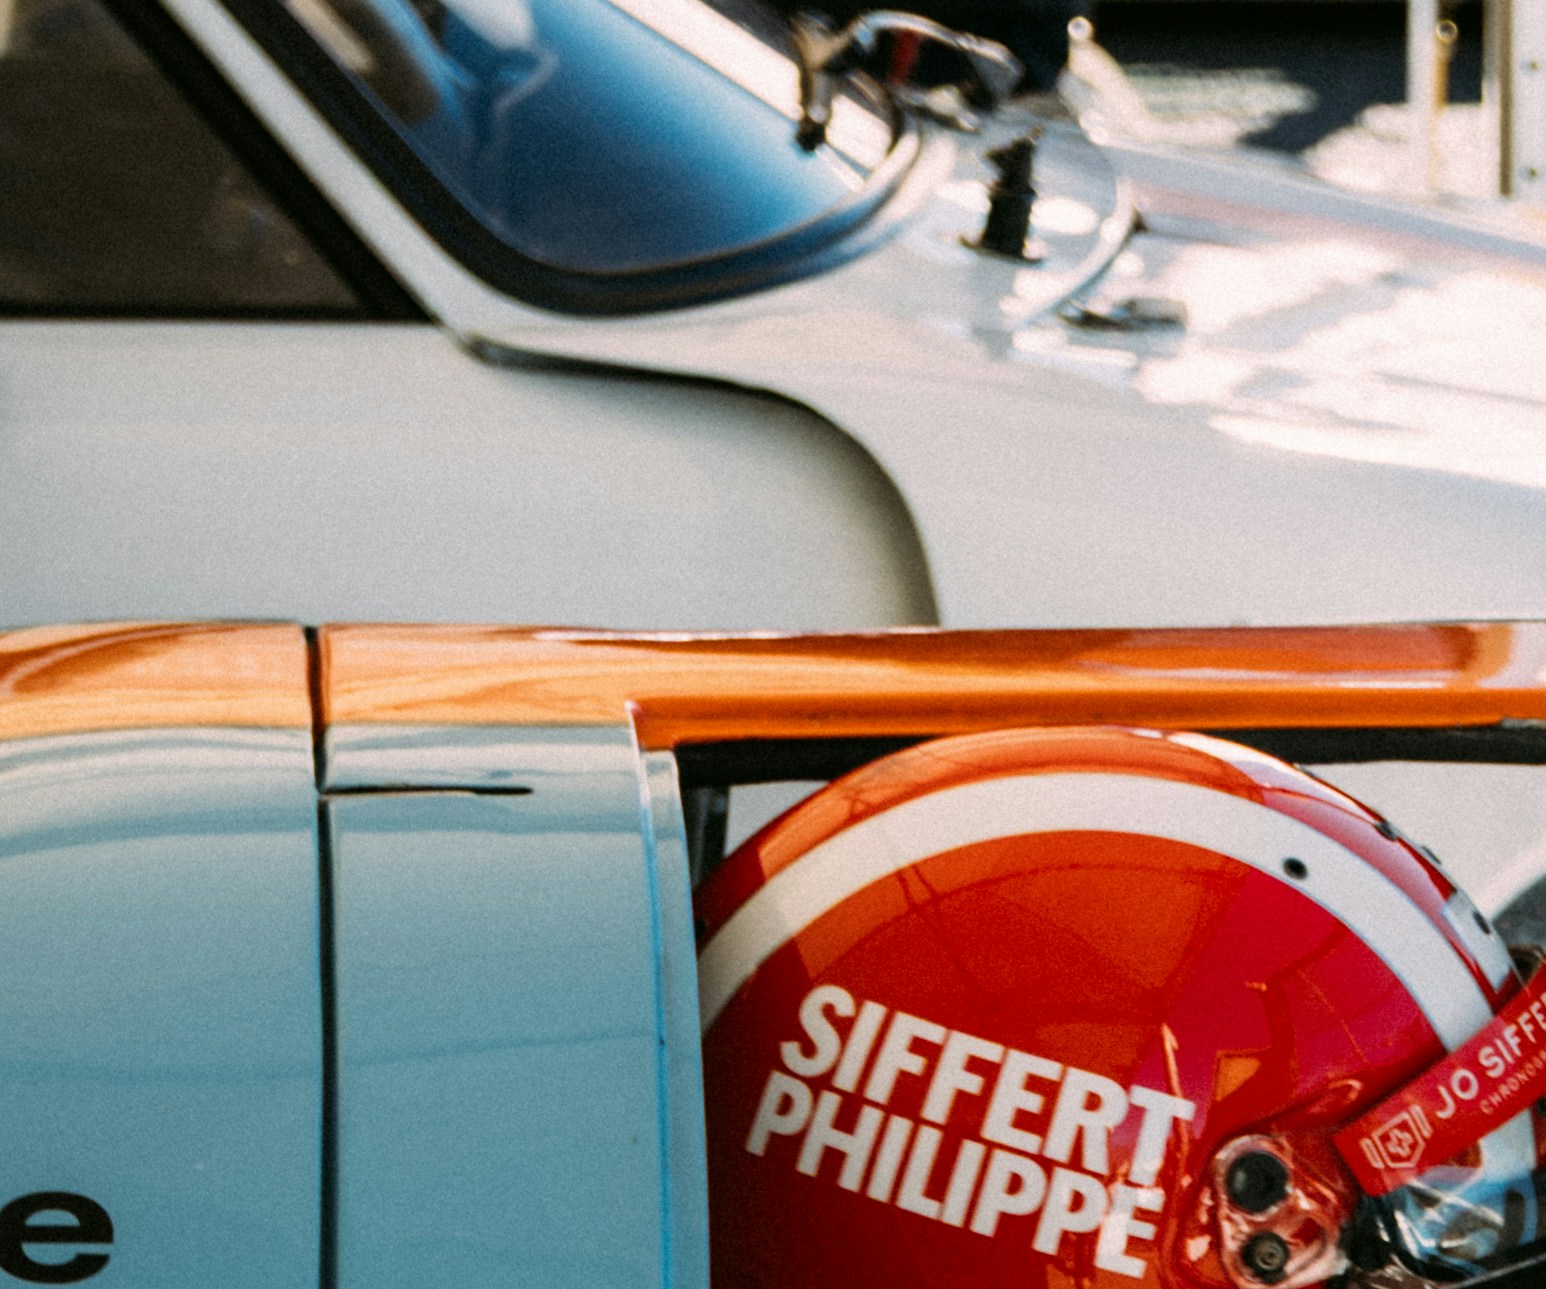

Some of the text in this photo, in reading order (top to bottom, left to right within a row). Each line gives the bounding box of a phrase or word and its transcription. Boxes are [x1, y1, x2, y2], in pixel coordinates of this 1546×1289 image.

[780, 984, 1196, 1187] SIFFERT
[1436, 1069, 1480, 1119] JO
[0, 1190, 115, 1285] e
[745, 1070, 1166, 1279] PHILIPPE
